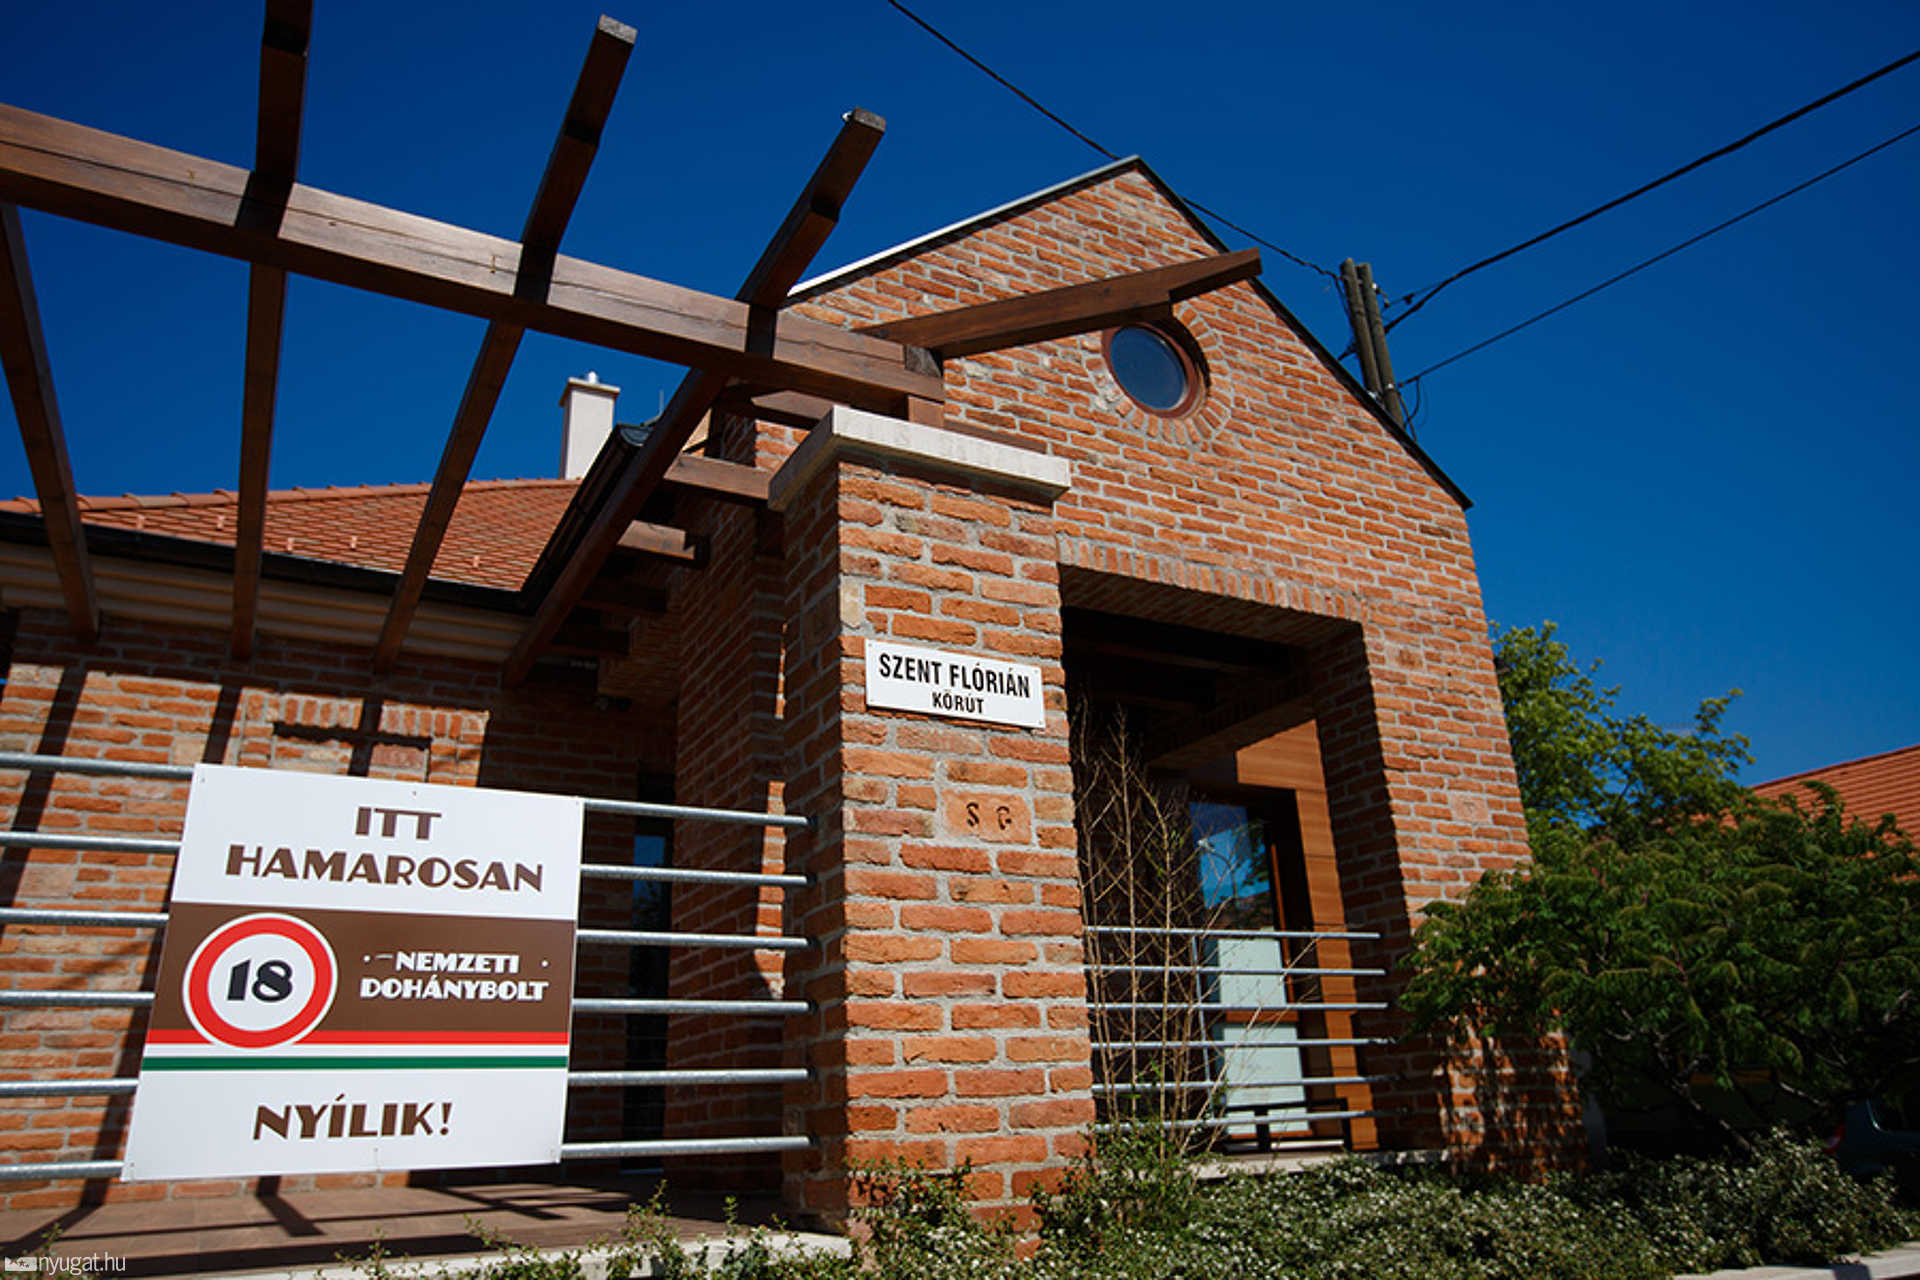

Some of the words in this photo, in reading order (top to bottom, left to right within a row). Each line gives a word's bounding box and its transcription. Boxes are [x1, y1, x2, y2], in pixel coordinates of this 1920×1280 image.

[880, 653, 941, 684] SZENT
[951, 663, 1030, 698] FLÓRIÁN
[356, 807, 441, 840] ITT
[226, 845, 542, 891] HAMAROSAN
[226, 958, 293, 1002] 18
[395, 951, 520, 974] NEMZETI
[360, 975, 548, 1000] DOHÁNYBOLT
[252, 1094, 453, 1141] NYÍLIK!
